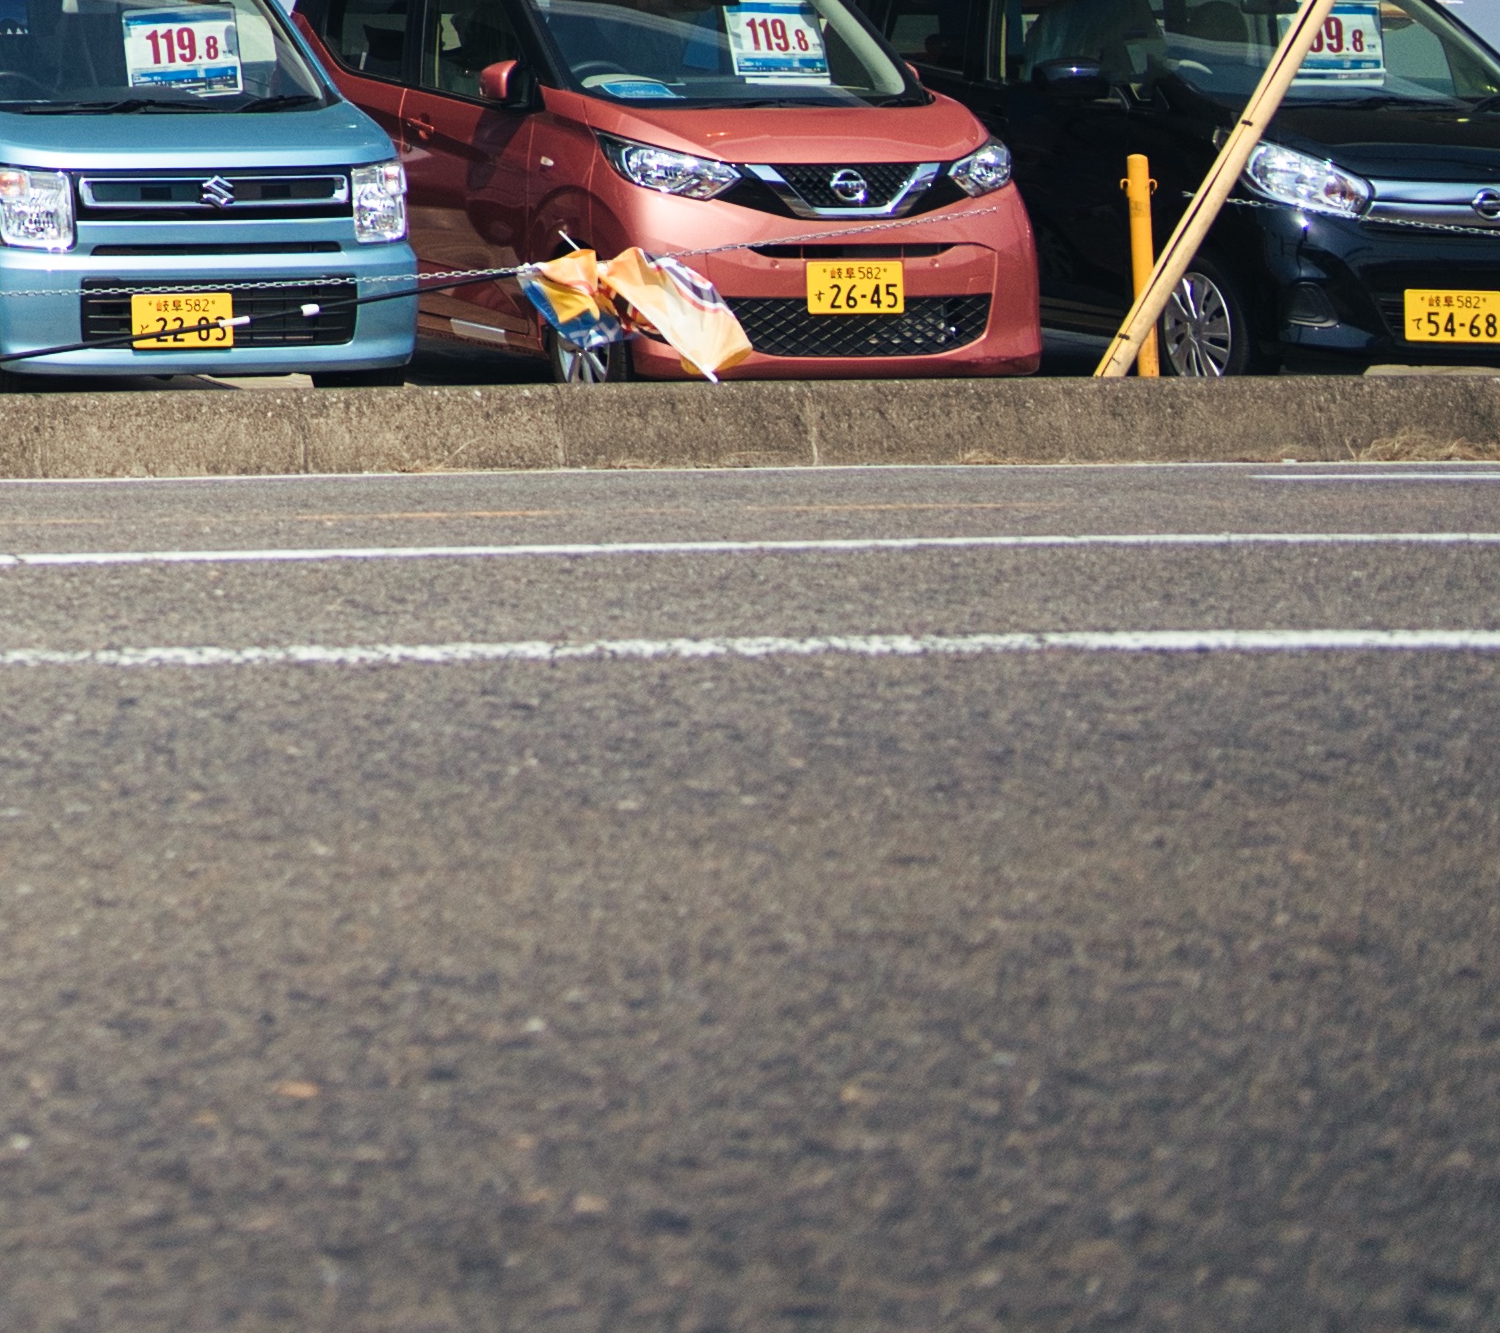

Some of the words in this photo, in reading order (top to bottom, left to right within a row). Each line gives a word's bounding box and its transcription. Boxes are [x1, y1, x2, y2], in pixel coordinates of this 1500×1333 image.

[145, 27, 219, 65] 119.8
[746, 18, 809, 52] 119.8
[829, 283, 898, 309] 26-45
[1426, 311, 1498, 338] 54-68
